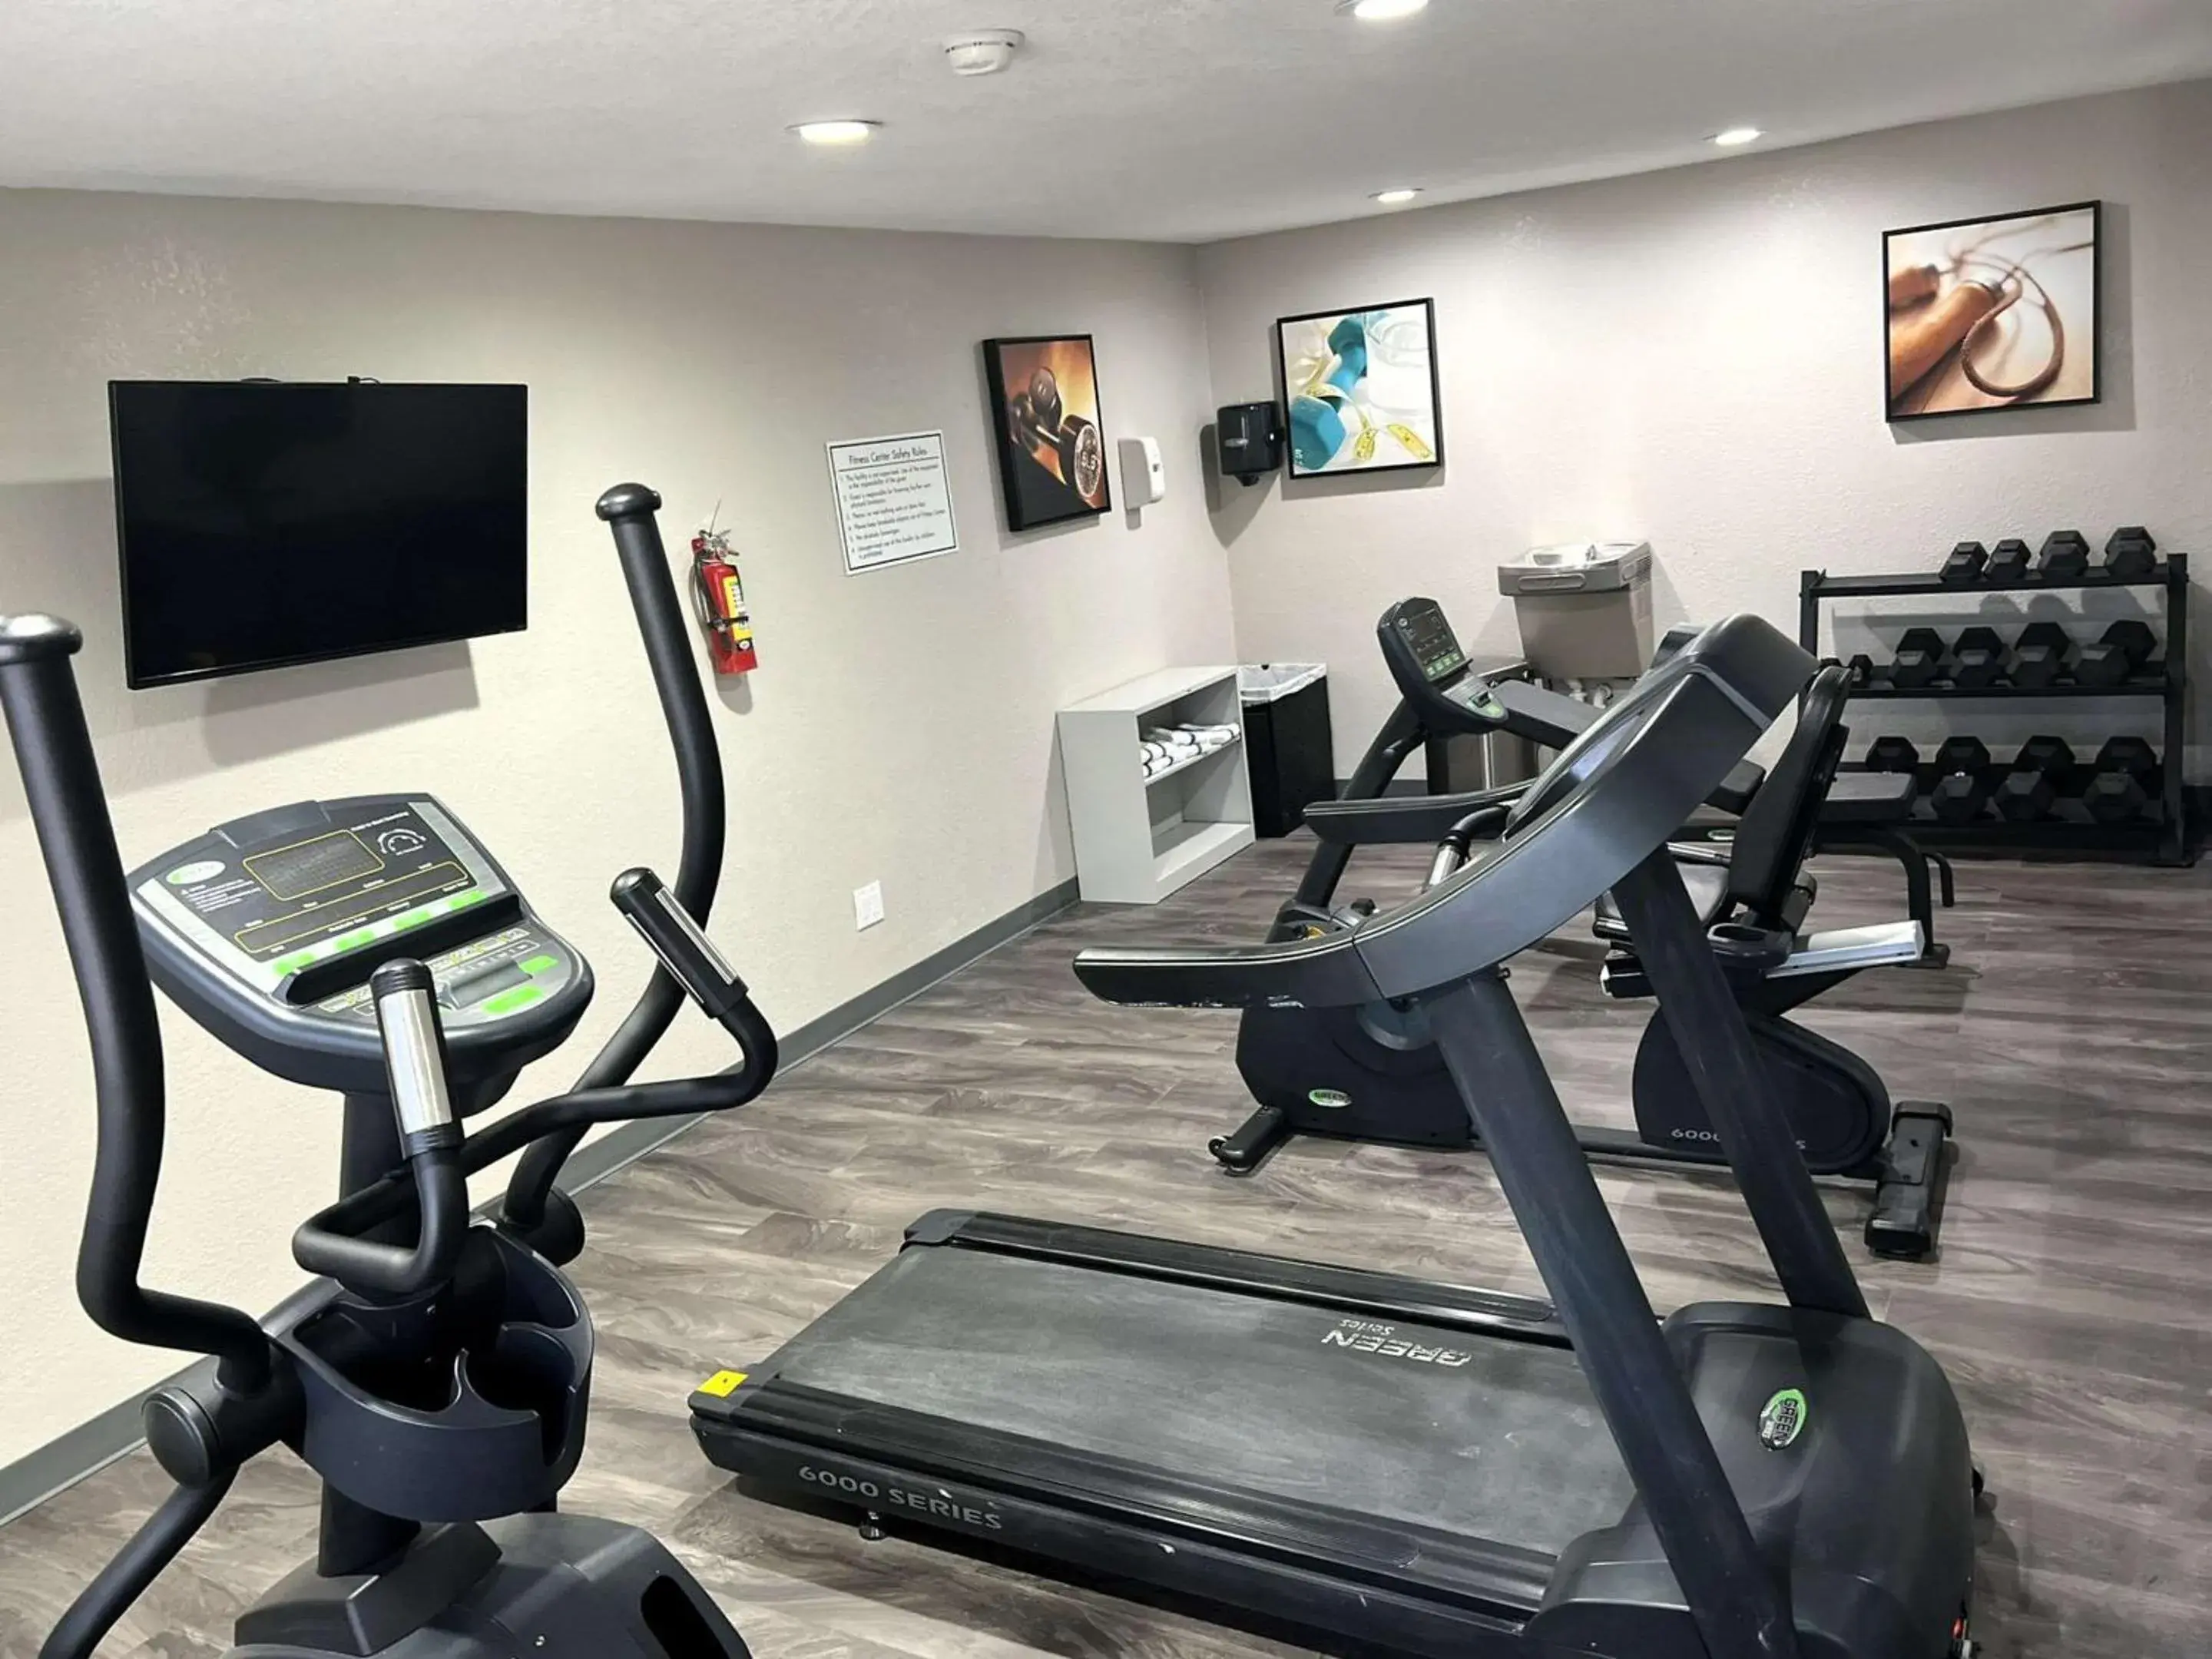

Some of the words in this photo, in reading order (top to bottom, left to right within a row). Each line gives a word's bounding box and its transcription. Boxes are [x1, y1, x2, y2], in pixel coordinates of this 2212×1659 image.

[849, 455, 870, 465] Fitness
[870, 452, 890, 462] Center
[891, 448, 910, 461] Safety
[1321, 1330, 1472, 1366] GREEN
[1773, 1398, 1798, 1442] GREEN
[799, 1466, 879, 1497] 6000
[889, 1488, 1002, 1529] SERIES
